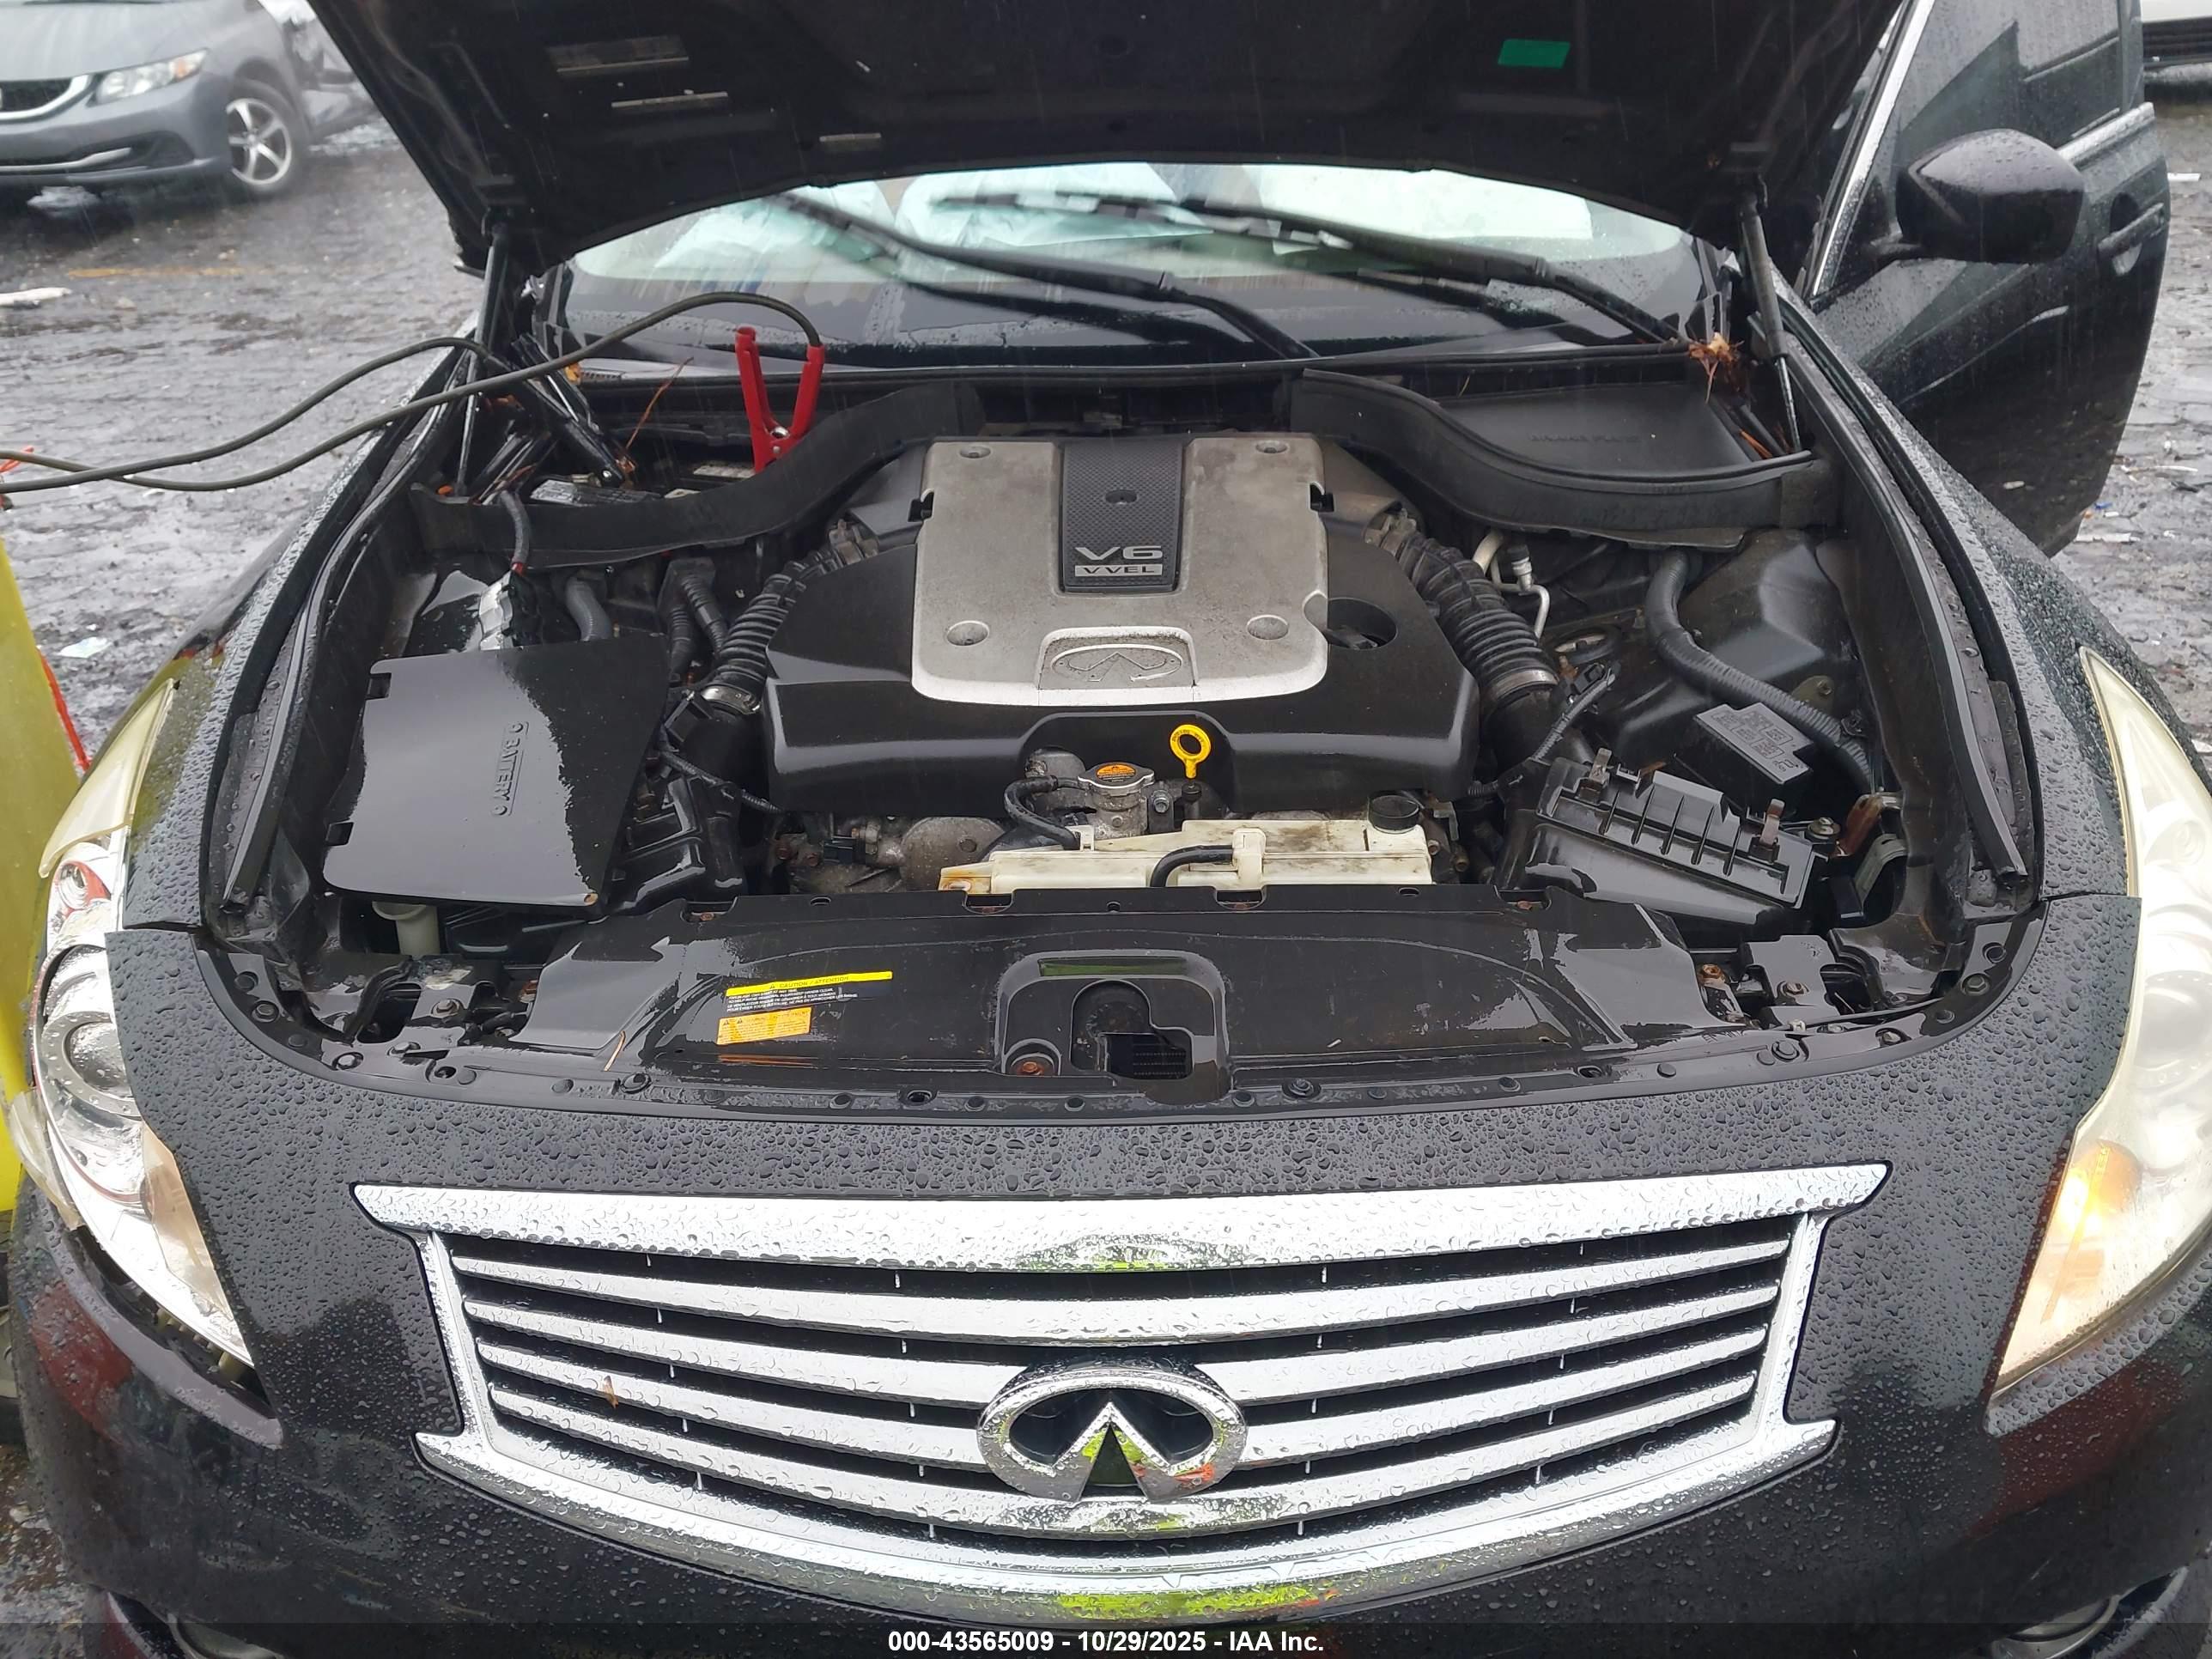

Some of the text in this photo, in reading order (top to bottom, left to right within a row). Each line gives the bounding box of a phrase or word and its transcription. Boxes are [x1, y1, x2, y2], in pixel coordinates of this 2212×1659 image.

[1075, 545, 1163, 560] V6
[1083, 566, 1156, 574] VVEL
[493, 738, 520, 800] BATTERY
[814, 975, 849, 984] ATTENTION
